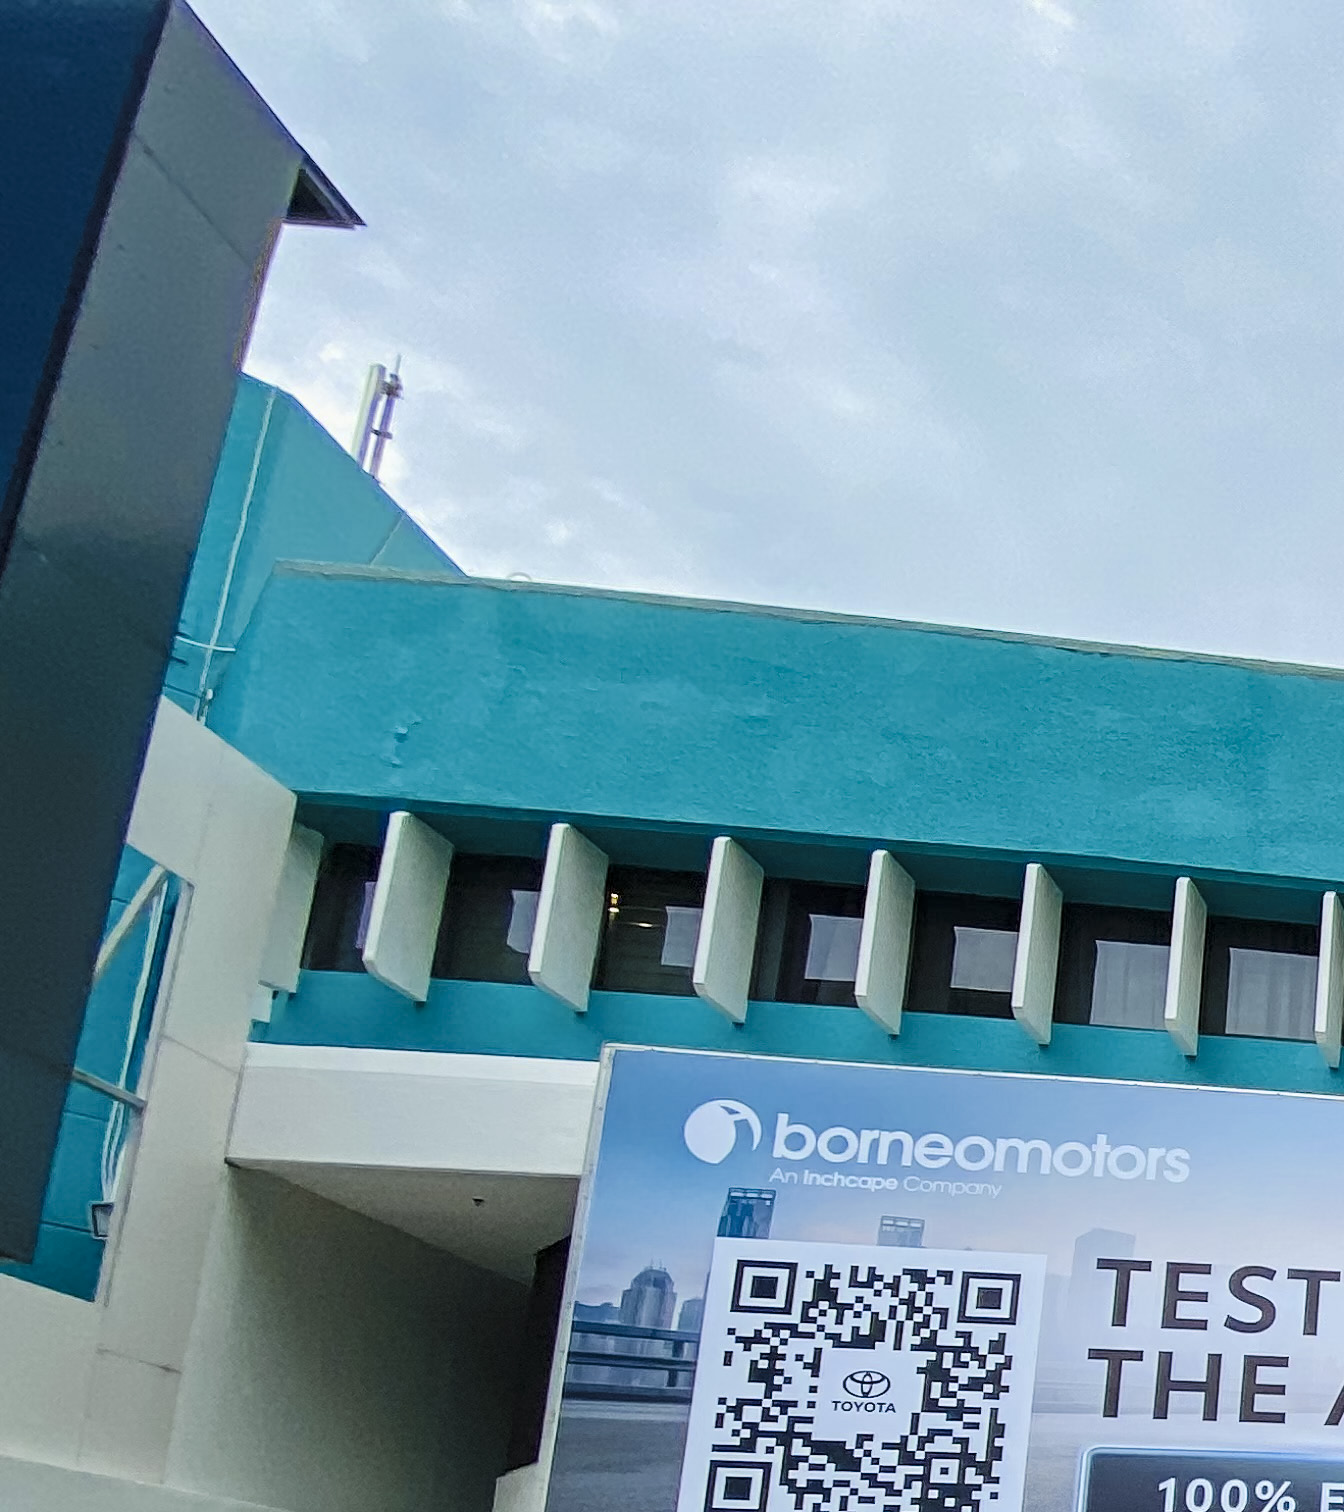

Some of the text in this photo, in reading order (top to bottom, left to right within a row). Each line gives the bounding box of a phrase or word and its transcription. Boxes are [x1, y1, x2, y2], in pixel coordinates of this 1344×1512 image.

[768, 1168, 1003, 1200] An Inchcape Company
[772, 1113, 1191, 1184] borneomotors
[1096, 1257, 1341, 1337] TEST
[831, 1400, 897, 1414] TOYOTA
[1087, 1348, 1290, 1424] THE
